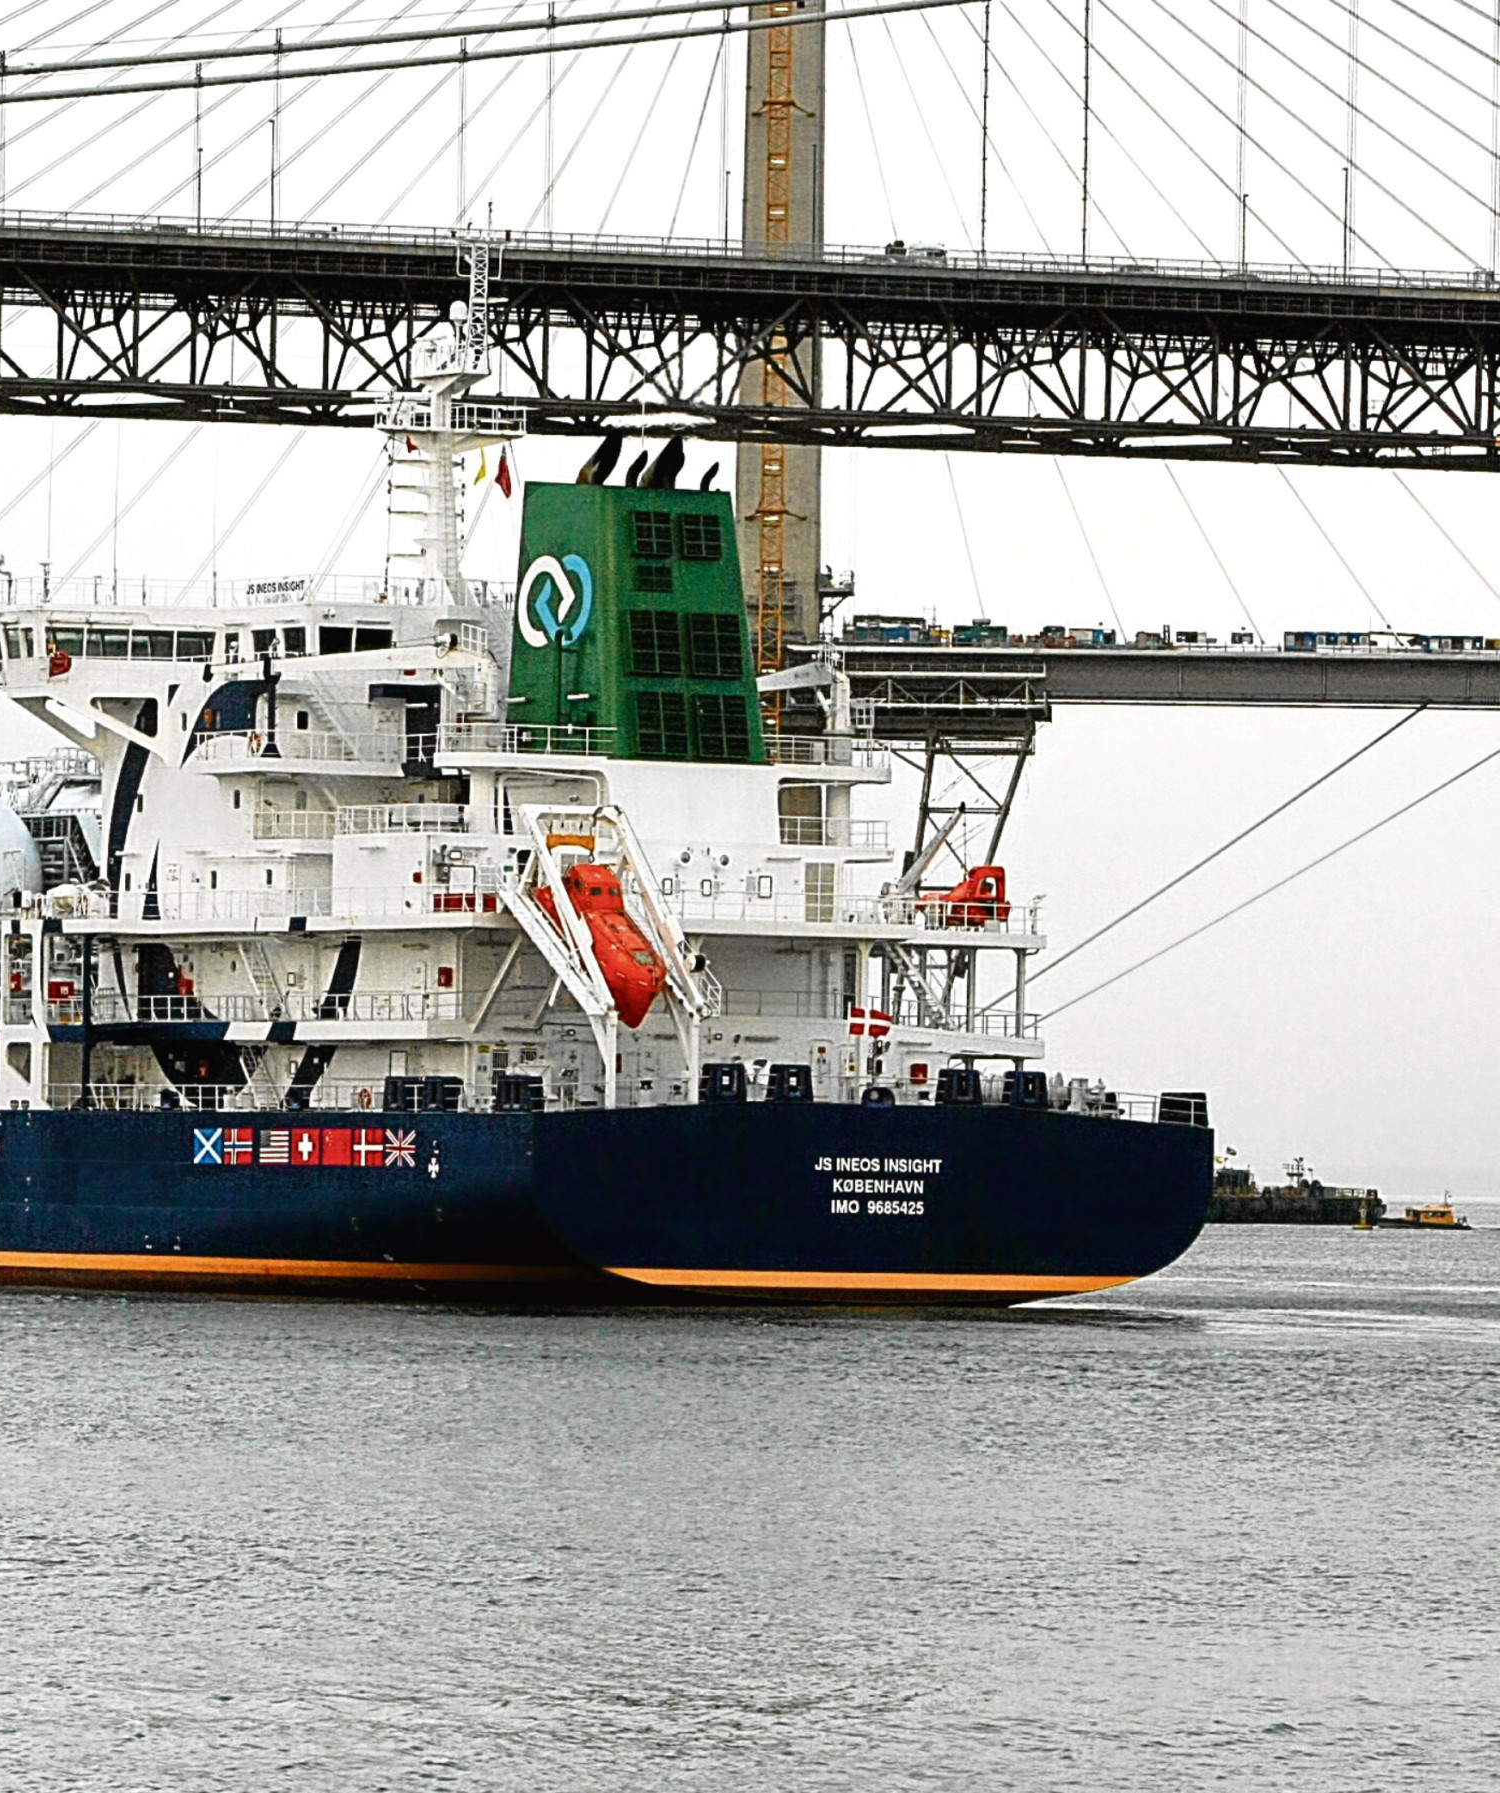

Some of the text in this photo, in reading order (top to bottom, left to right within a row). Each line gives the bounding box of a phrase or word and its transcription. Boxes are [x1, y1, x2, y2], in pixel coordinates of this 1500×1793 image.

[277, 579, 305, 592] INSIGHT
[814, 1156, 943, 1174] JS INEOS INSIGHT
[832, 1178, 925, 1195] KØBENHAVN
[830, 1199, 925, 1216] IMO 9685425
